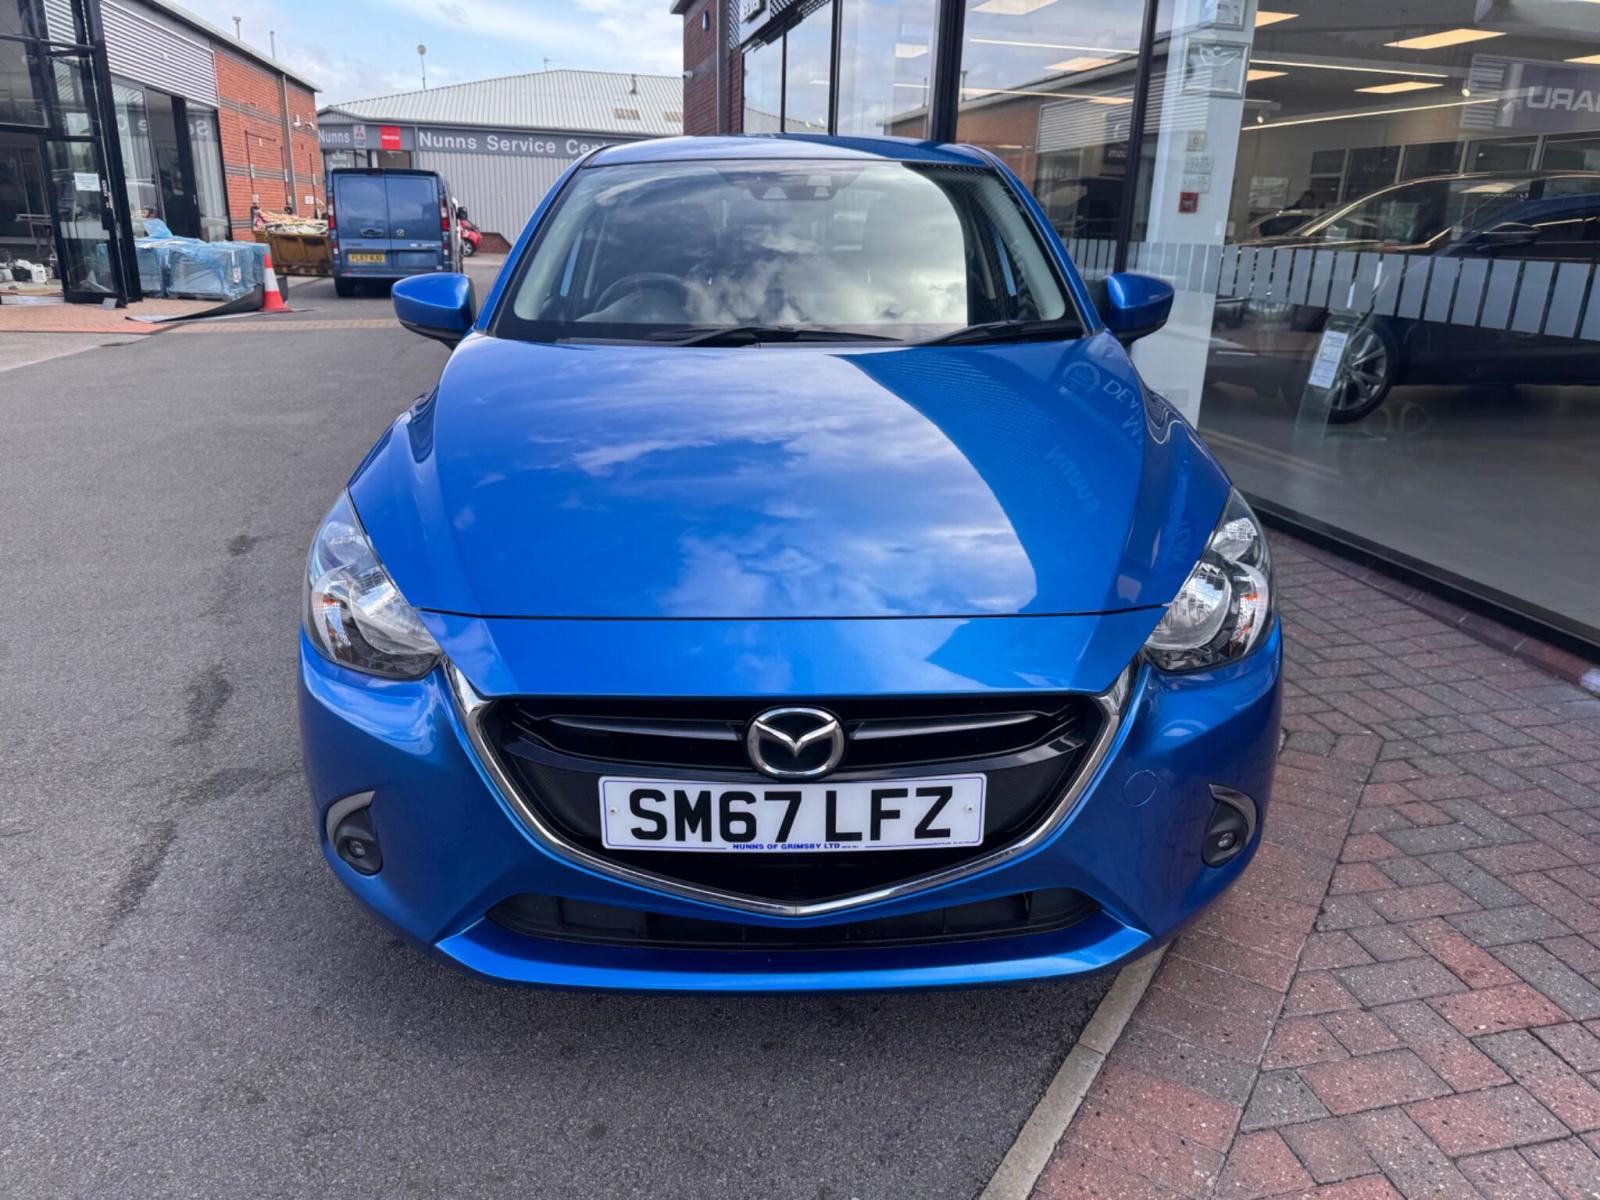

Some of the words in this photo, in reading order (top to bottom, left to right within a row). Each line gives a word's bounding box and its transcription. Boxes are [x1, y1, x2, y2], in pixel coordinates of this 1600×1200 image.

[318, 129, 351, 144] Nunns
[418, 131, 477, 150] Nunns
[486, 135, 556, 153] Service
[629, 788, 802, 843] SM67
[825, 786, 954, 842] LFZ
